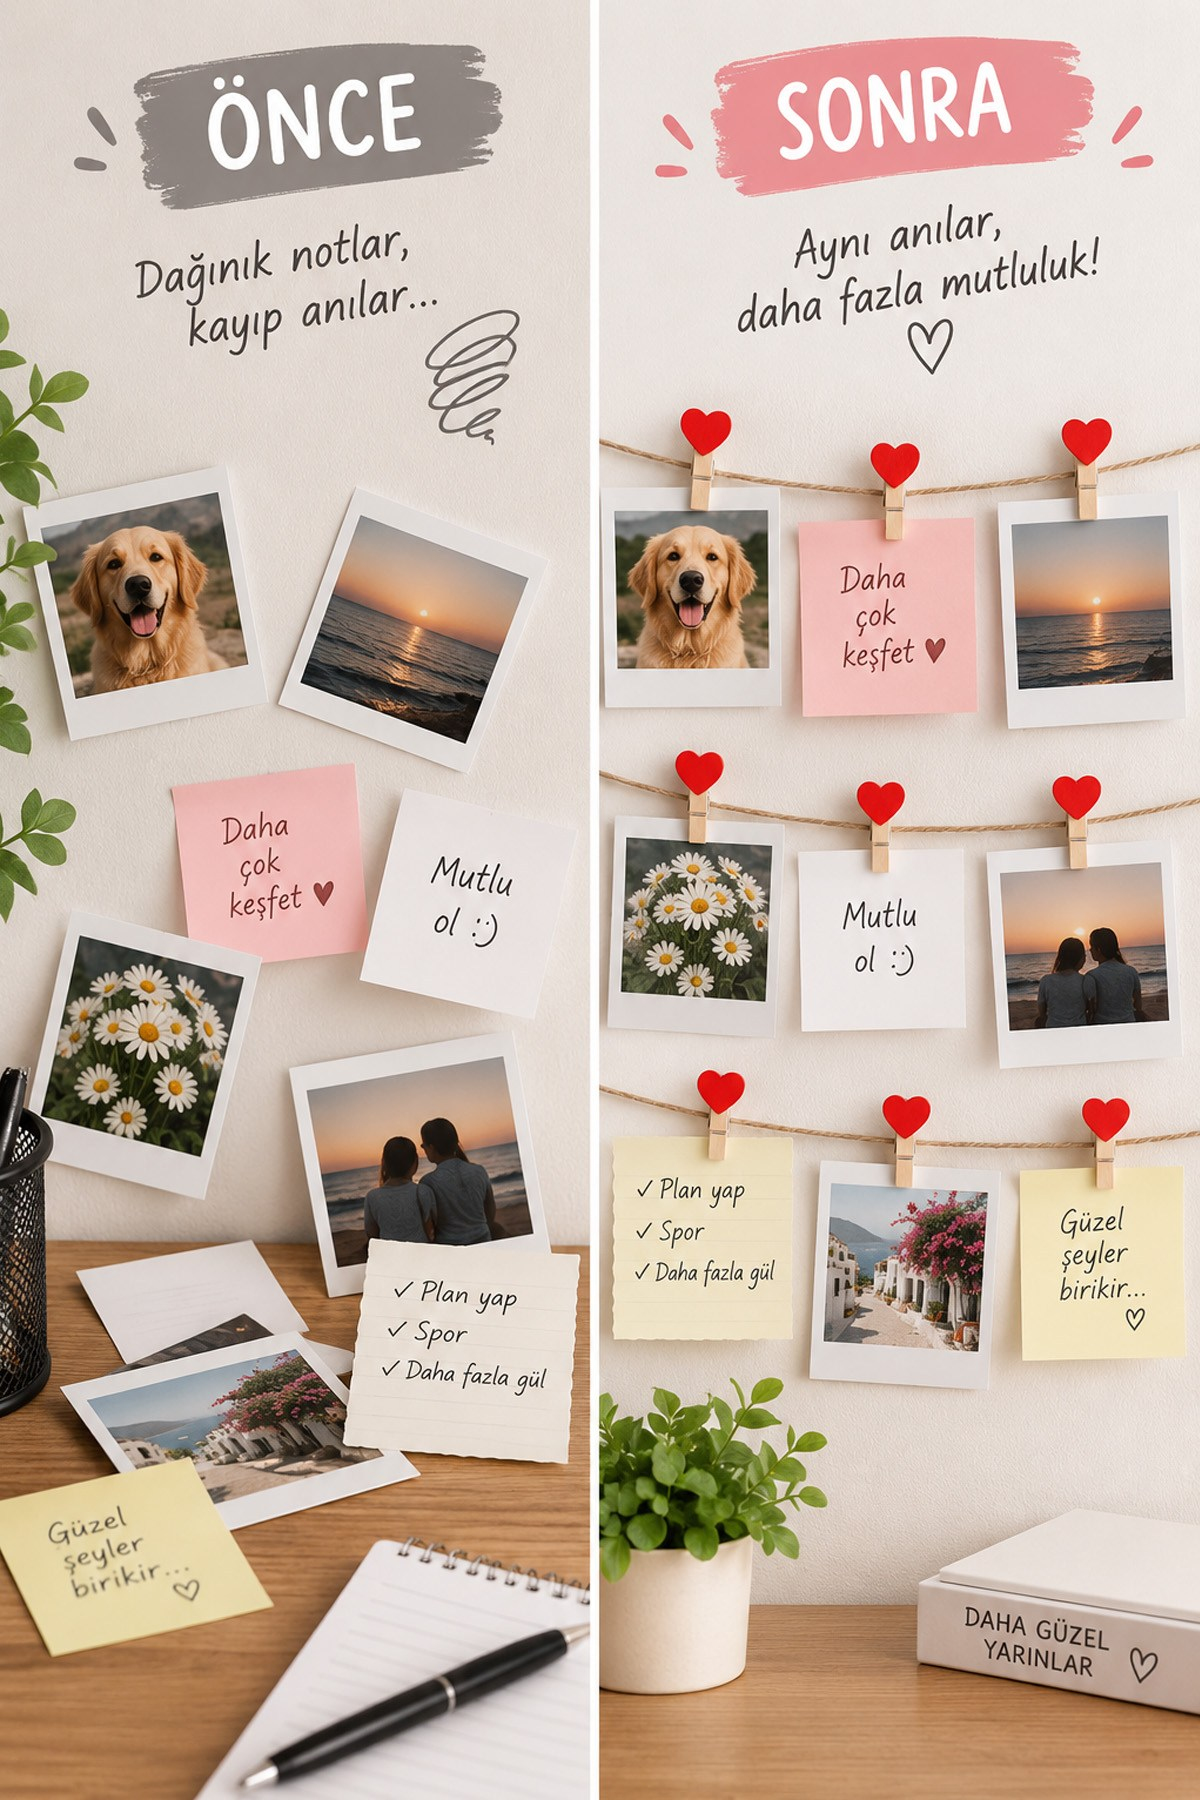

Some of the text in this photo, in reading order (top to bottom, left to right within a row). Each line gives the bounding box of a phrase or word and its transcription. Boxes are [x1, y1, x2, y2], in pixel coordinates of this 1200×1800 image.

[840, 562, 906, 595] Daha
[855, 598, 897, 638] çok
[842, 637, 915, 674] keşfet
[221, 810, 289, 846] Daha
[240, 846, 281, 887] çok
[430, 855, 513, 897] Mutlu
[230, 883, 303, 922] keşfet
[842, 897, 917, 931] Mutlu
[433, 906, 462, 937] ol
[854, 944, 876, 973] ol
[660, 1176, 746, 1209] Plan yap
[658, 1219, 706, 1250] Spor
[1060, 1205, 1125, 1240] Güzel
[654, 1259, 776, 1291] Daha fazla gül
[1061, 1239, 1129, 1275] şeyler
[420, 1279, 518, 1316] Plan yap
[1059, 1275, 1146, 1302] birikir...
[413, 1319, 469, 1351] Spor
[405, 1359, 548, 1397] Daha fazla gül
[48, 1505, 127, 1546] Güzel
[64, 1537, 146, 1581] şeyler
[70, 1563, 190, 1599] birikir...
[964, 1606, 1110, 1652] DAHA GÜZEL
[983, 1638, 1094, 1678] YARINLAR
